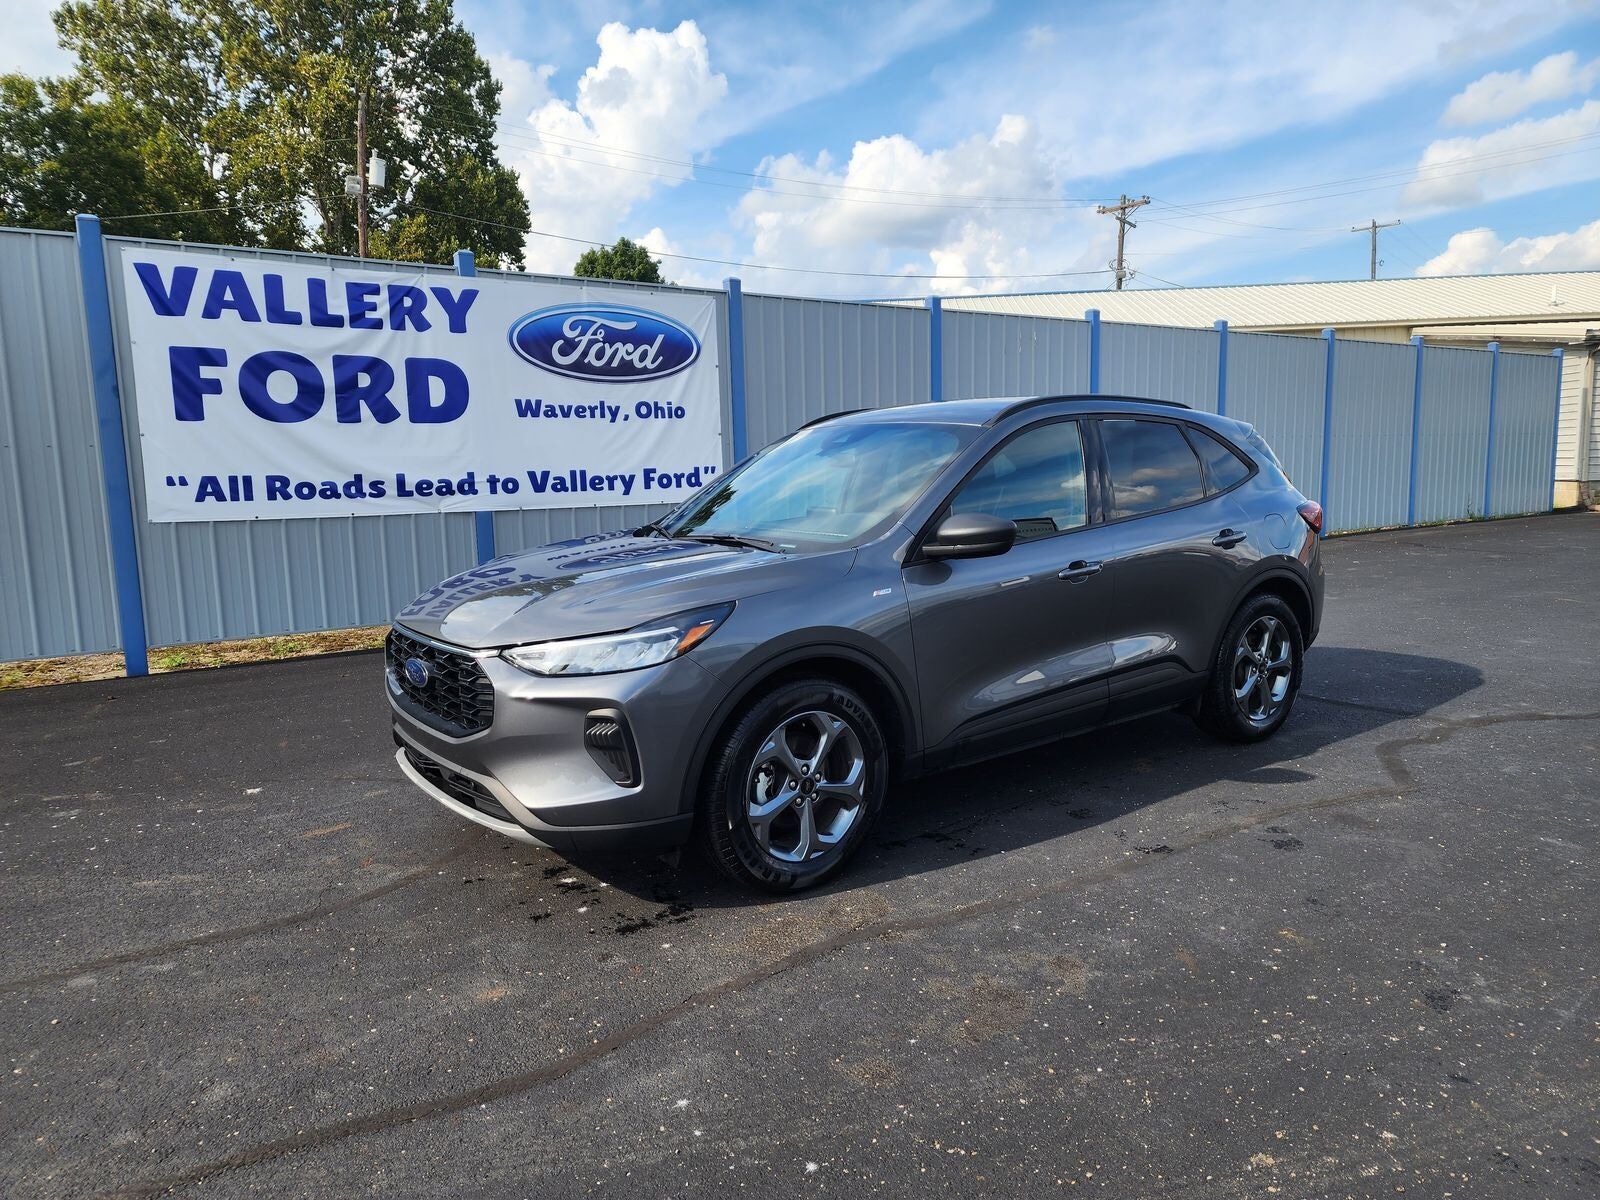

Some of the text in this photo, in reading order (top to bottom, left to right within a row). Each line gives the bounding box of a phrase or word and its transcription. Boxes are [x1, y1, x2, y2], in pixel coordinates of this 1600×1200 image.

[132, 262, 480, 334] VALLERY
[551, 315, 665, 370] Ford
[168, 345, 470, 424] FORD
[514, 398, 686, 427] Waverly, Ohio
[265, 473, 387, 502] Roads
[395, 471, 479, 498] Lead
[486, 474, 520, 496] to
[526, 469, 636, 496] Vallery
